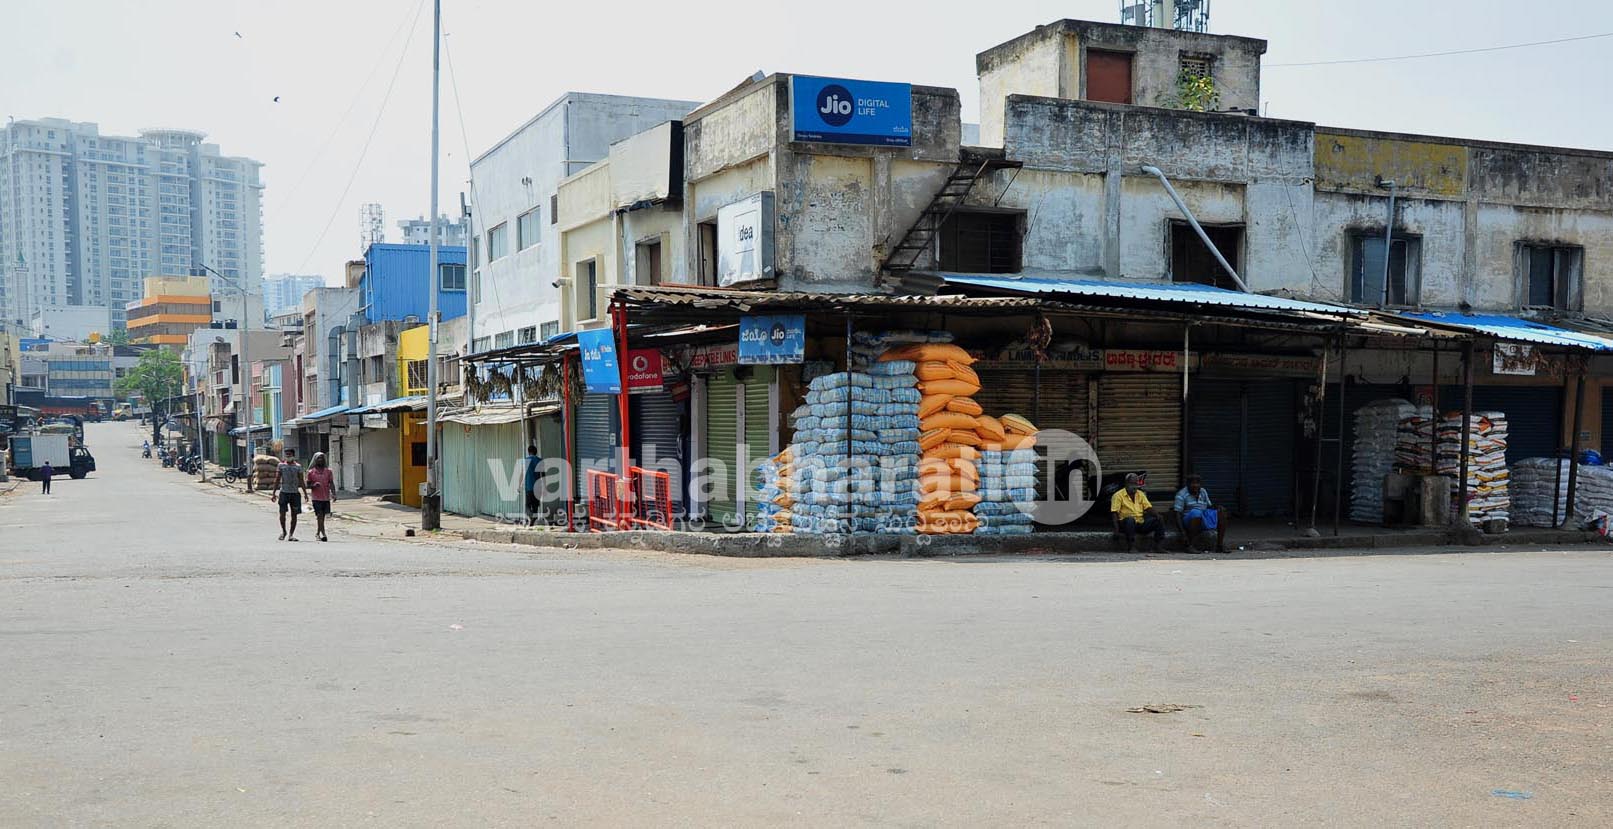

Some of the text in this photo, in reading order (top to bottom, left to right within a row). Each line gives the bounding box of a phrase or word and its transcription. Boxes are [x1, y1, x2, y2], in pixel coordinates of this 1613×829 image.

[820, 94, 852, 115] Jio
[857, 97, 890, 109] DIGITAL
[857, 107, 876, 117] LIFE
[771, 328, 785, 340] Jio
